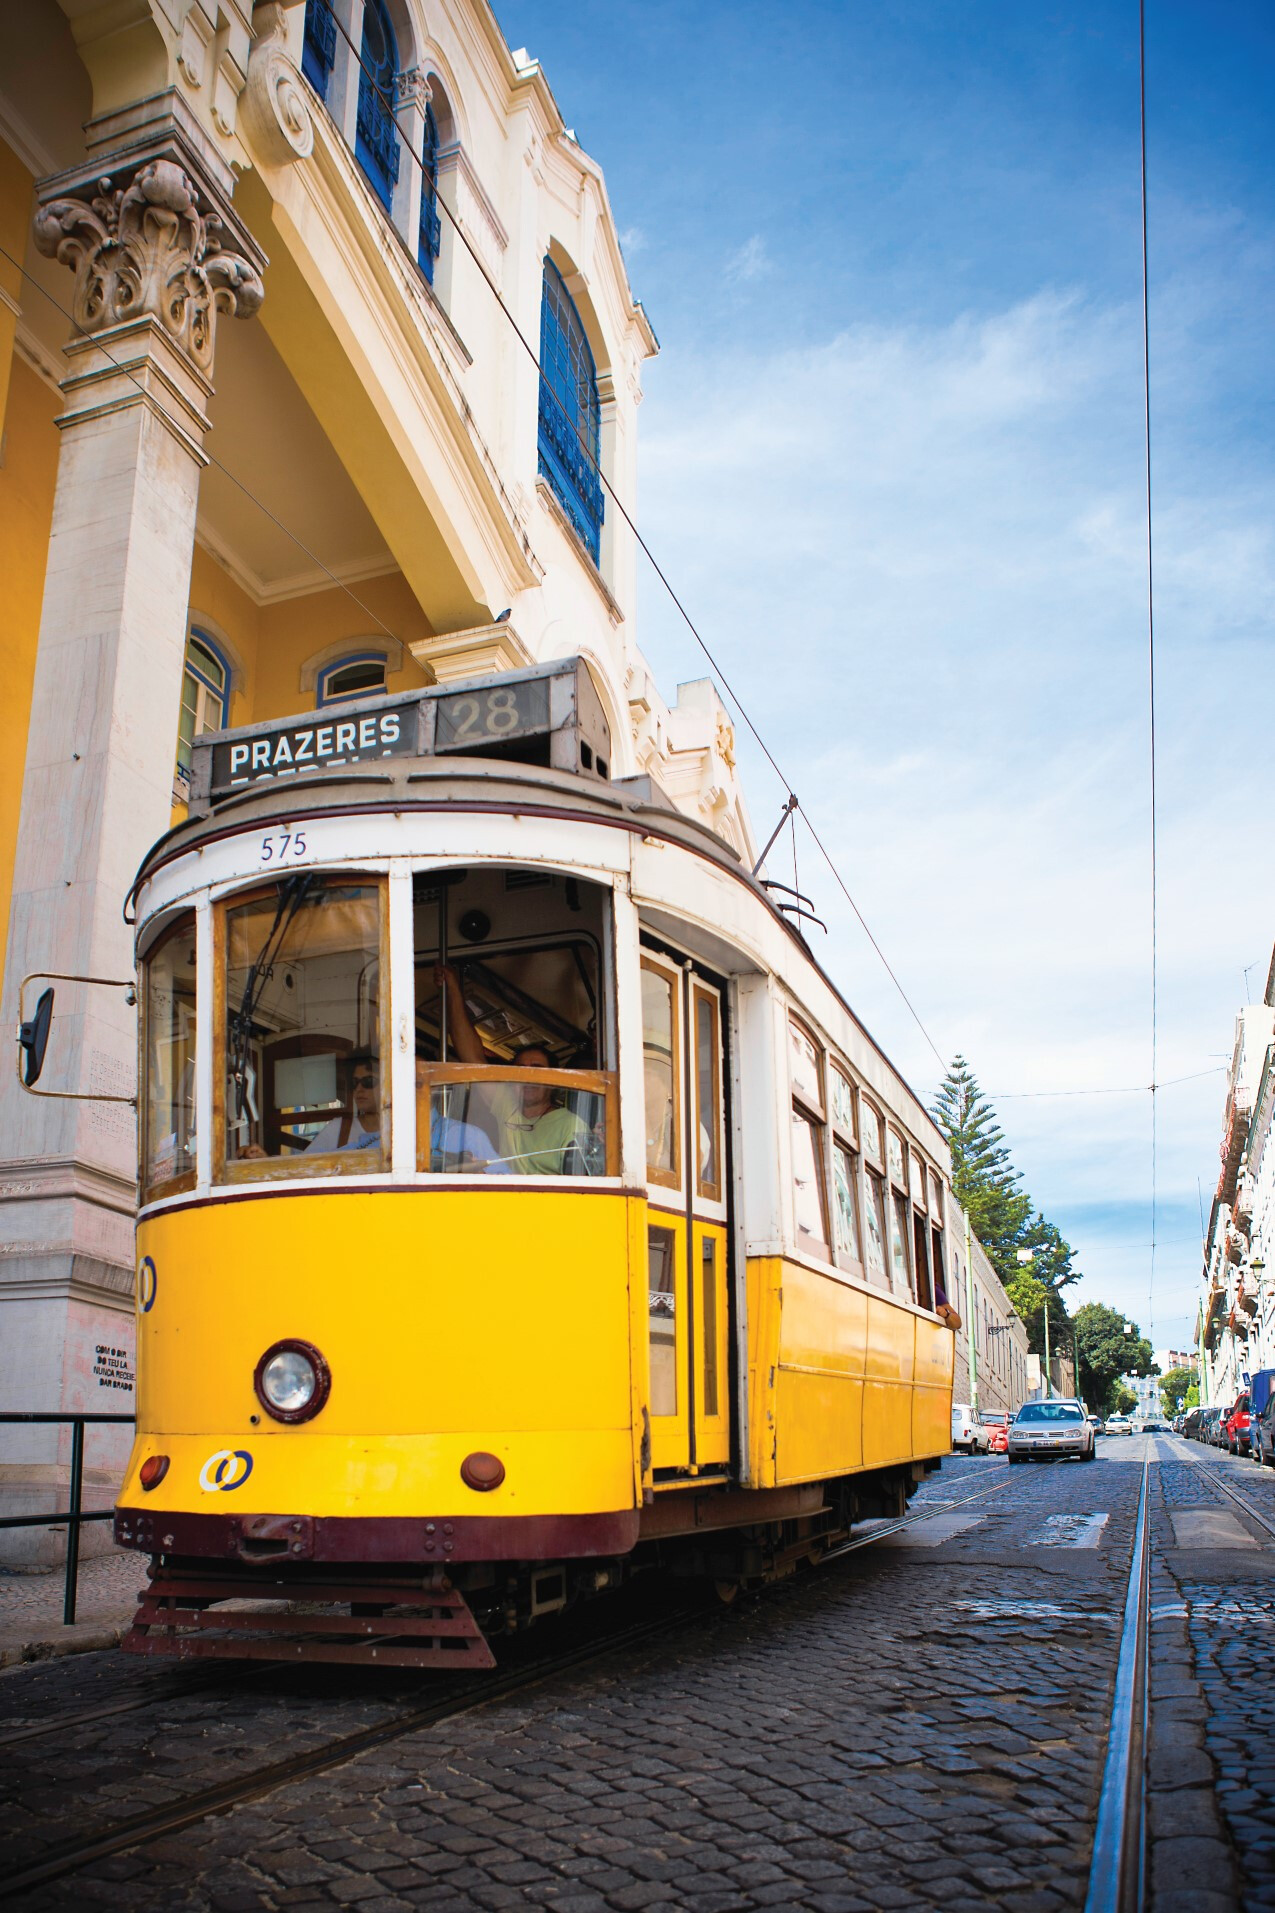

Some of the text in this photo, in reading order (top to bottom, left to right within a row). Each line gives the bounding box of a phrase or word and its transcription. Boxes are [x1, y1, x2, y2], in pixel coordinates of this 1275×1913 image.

[451, 688, 519, 742] 28
[230, 713, 401, 774] PRAZERES
[261, 832, 306, 861] 575
[93, 1365, 115, 1378] NUNCA
[108, 1358, 119, 1368] TEU
[99, 1377, 133, 1392] DAR BRADO
